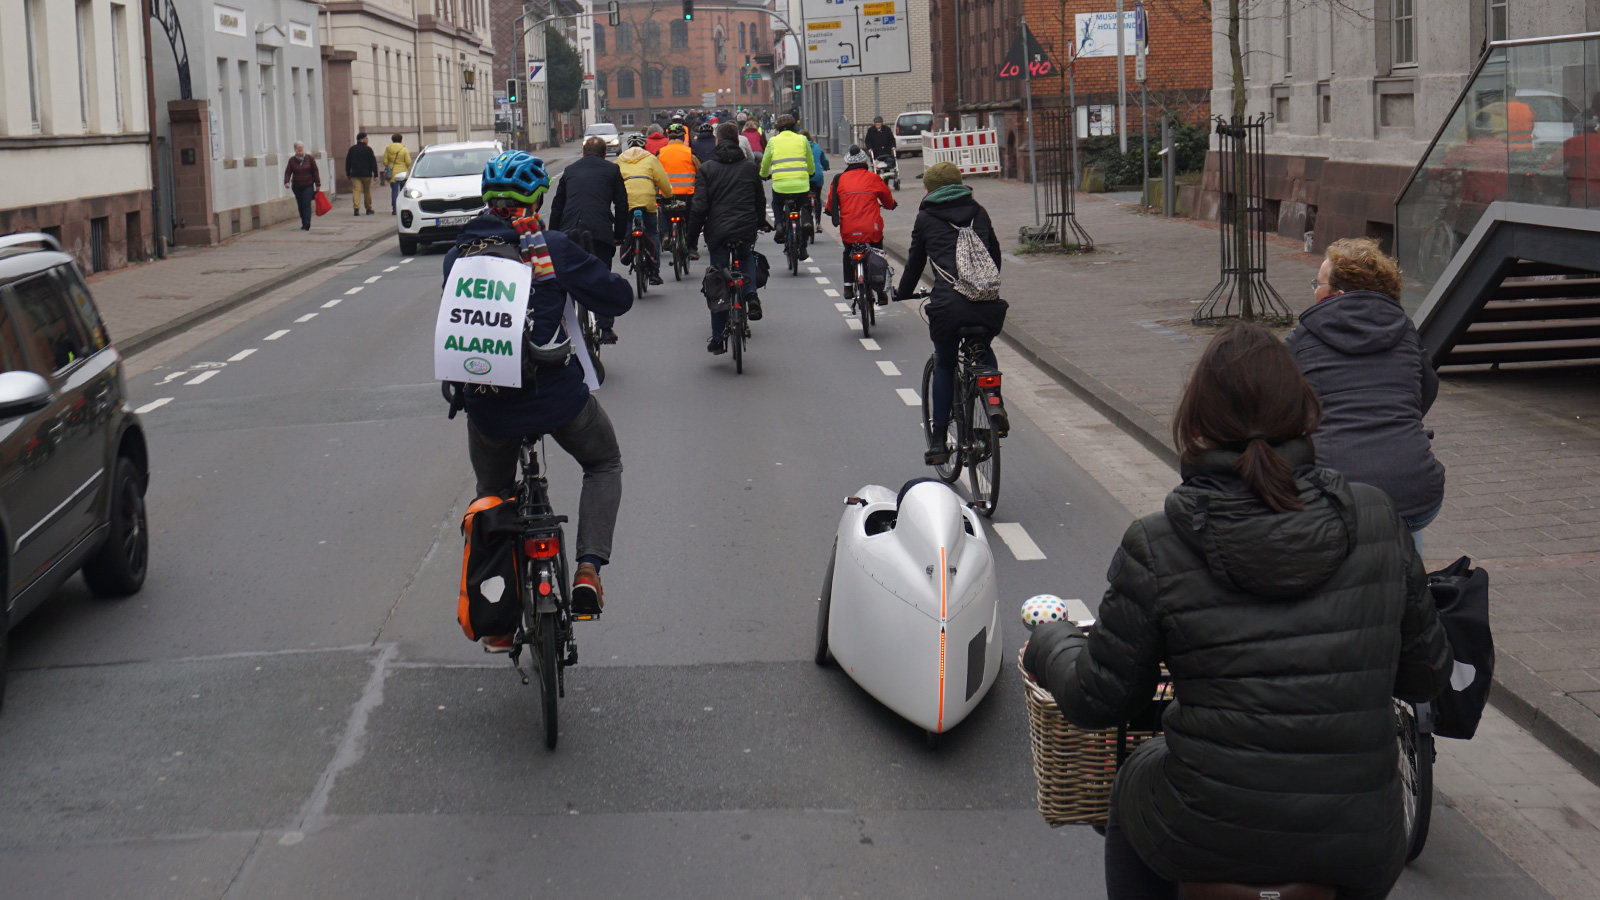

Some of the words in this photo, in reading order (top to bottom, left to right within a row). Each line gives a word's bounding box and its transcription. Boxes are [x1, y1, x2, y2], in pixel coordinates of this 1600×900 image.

[455, 277, 517, 302] KEIN
[450, 308, 512, 328] STAUB
[444, 335, 513, 356] ALARM
